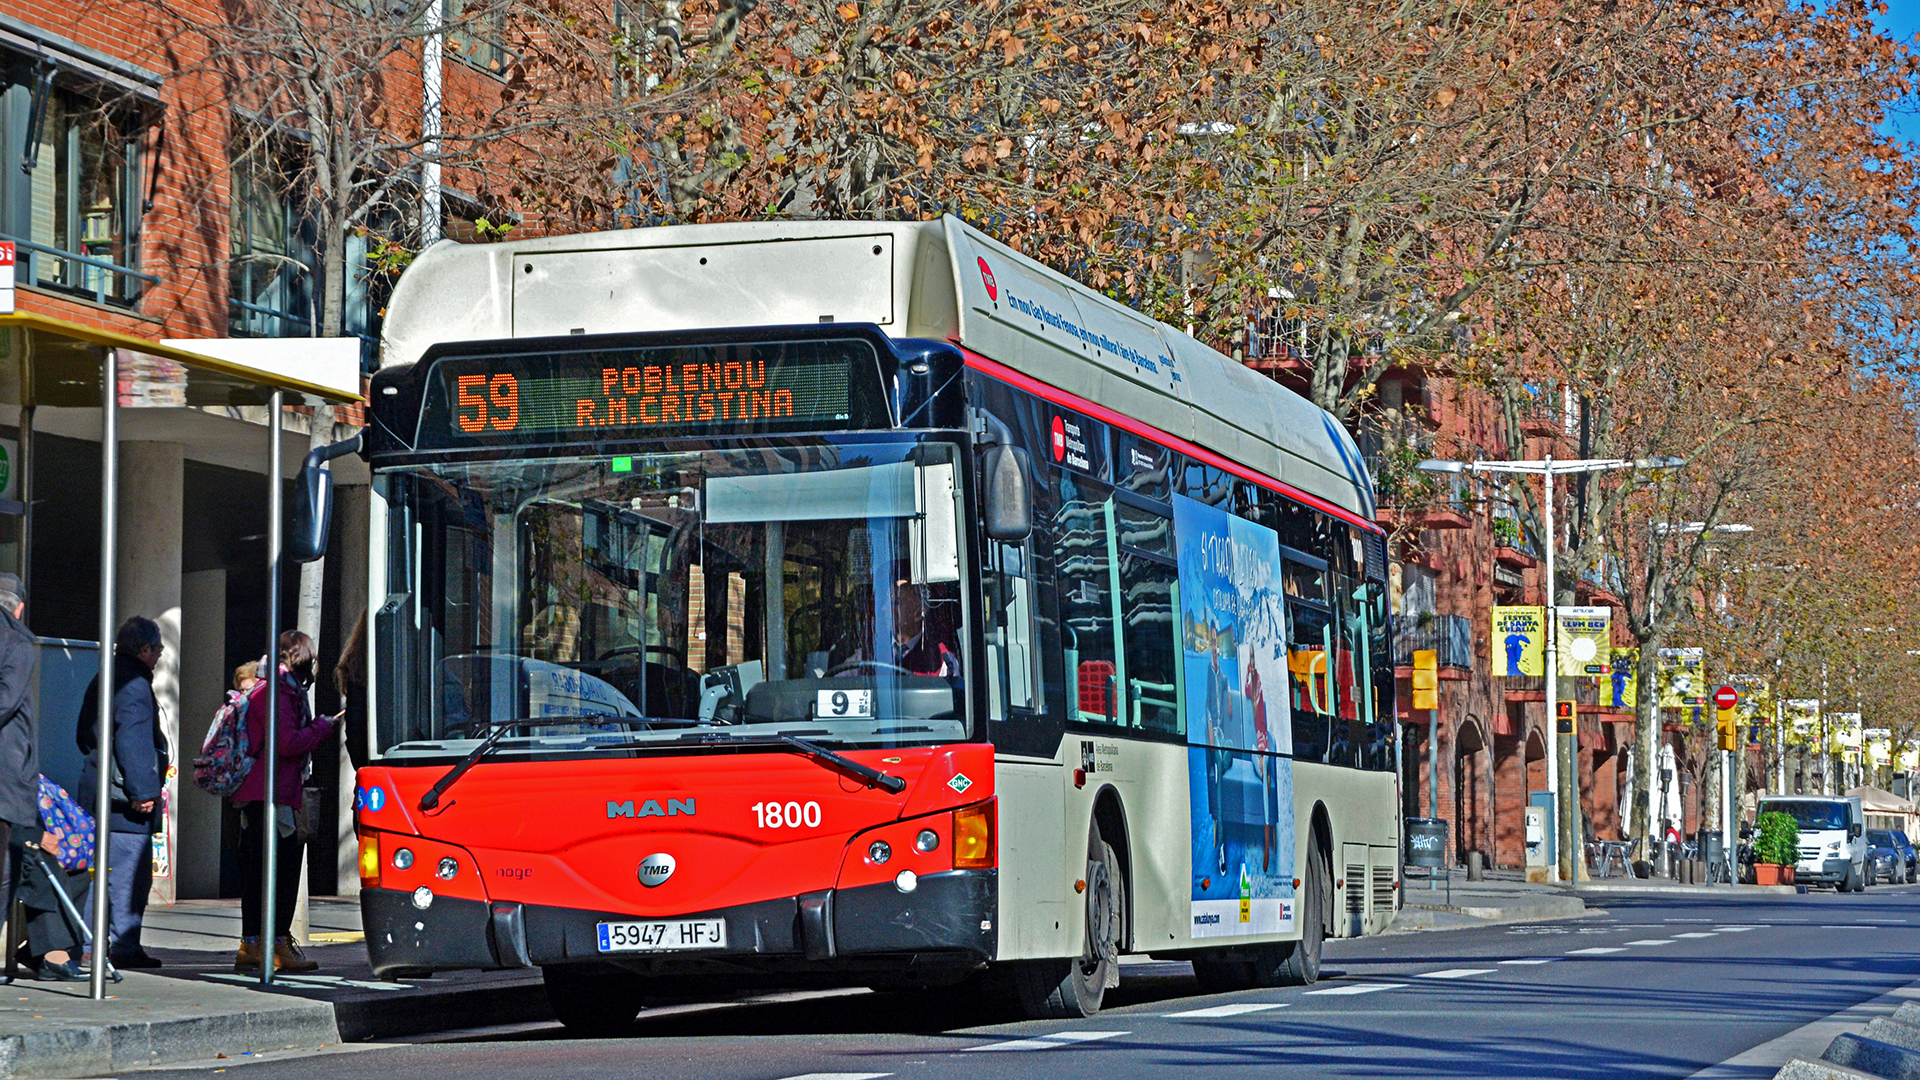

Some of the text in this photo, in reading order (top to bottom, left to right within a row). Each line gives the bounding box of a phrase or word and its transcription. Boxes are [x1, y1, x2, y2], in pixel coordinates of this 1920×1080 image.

[602, 359, 765, 396] POBLENOU
[457, 373, 518, 433] 59
[576, 389, 793, 427] R.M.CRISTINA
[831, 690, 850, 716] 9
[951, 779, 968, 788] GNC
[606, 798, 696, 818] MAN
[751, 801, 822, 828] 1800
[496, 868, 534, 880] noge
[643, 865, 670, 876] TMB
[613, 922, 721, 946] 5947 HFJ
